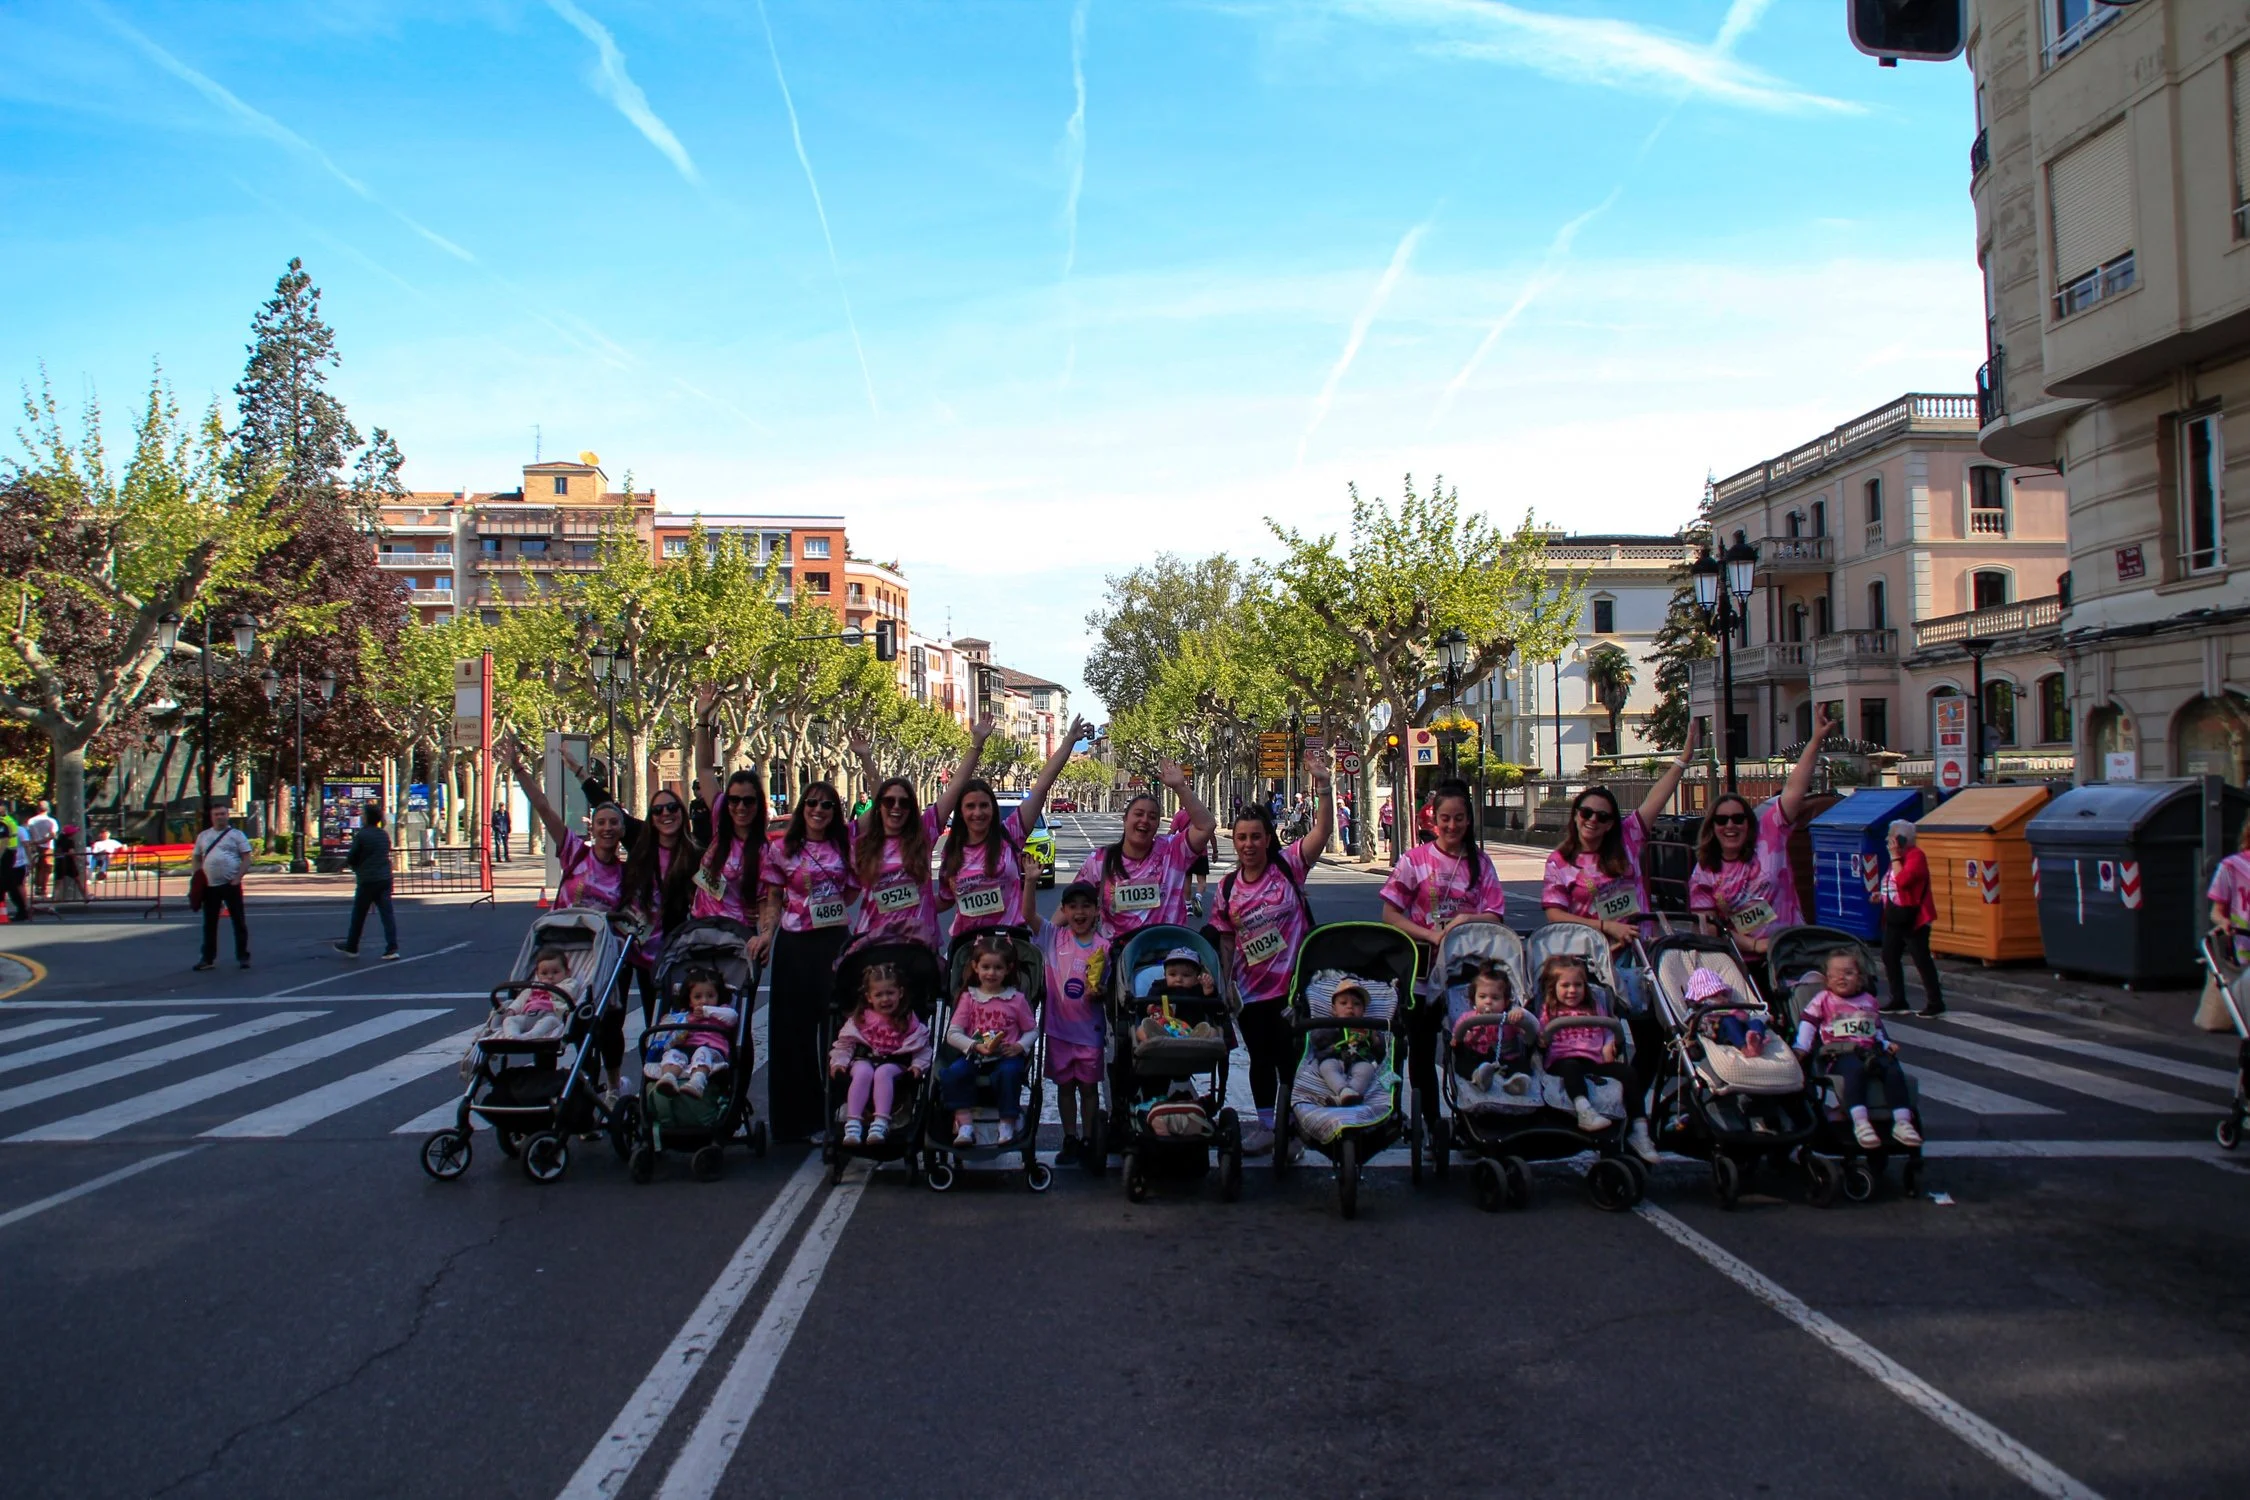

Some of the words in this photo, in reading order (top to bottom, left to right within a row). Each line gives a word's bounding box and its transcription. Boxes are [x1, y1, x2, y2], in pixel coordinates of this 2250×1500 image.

[881, 887, 911, 905] 9524
[961, 891, 999, 909] 11030
[1119, 887, 1155, 901] 11033
[816, 904, 843, 918] 4869
[1603, 895, 1630, 914] 1559
[1737, 907, 1765, 926] 7874
[1246, 933, 1278, 956] 11034
[1841, 1020, 1871, 1035] 1542
